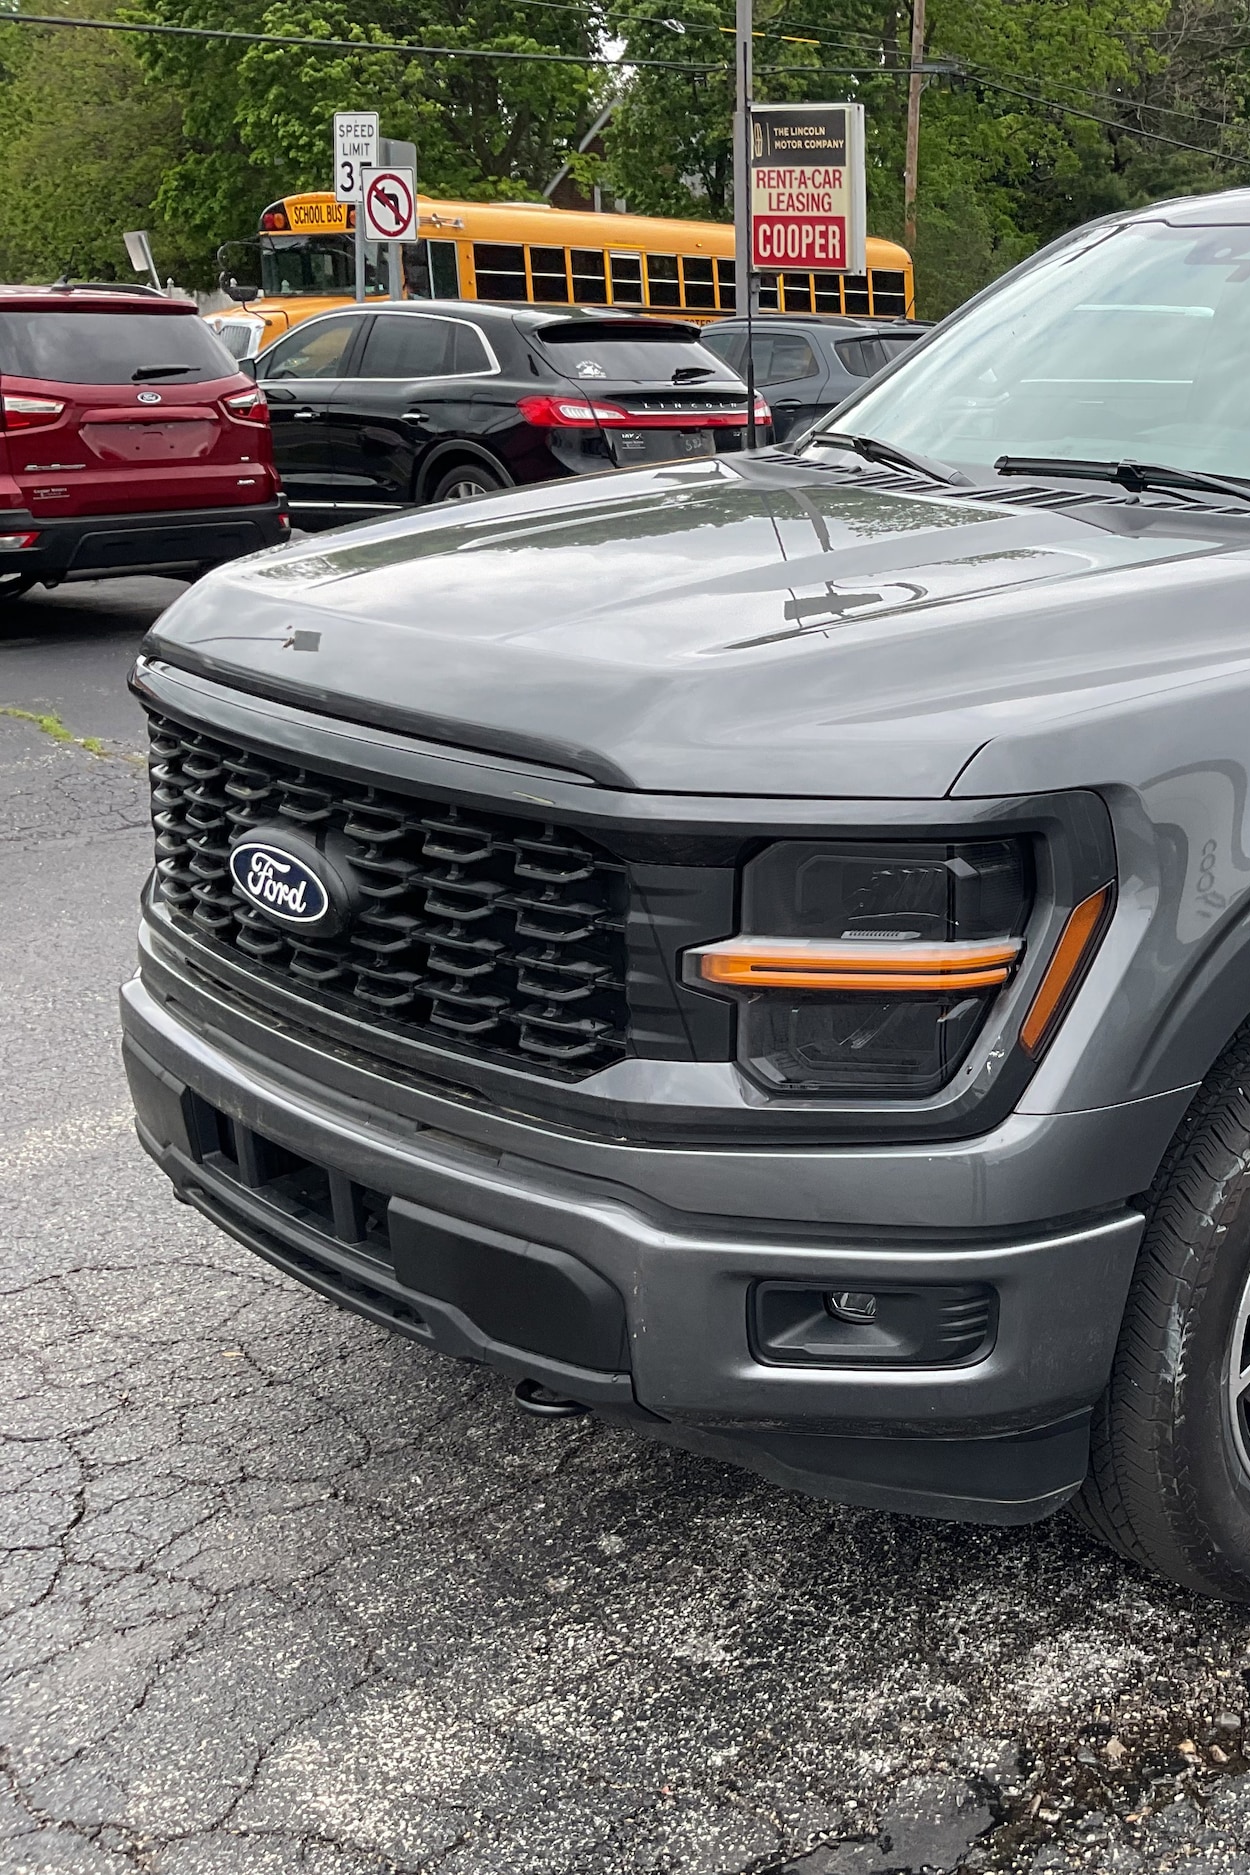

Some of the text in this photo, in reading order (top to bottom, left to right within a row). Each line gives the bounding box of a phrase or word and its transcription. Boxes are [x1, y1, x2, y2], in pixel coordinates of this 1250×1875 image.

[339, 124, 375, 138] SPEED
[773, 126, 826, 137] THE LINCOLN
[342, 143, 370, 156] LIMIT
[774, 139, 844, 149] MOTOR COMPANY
[756, 169, 843, 189] RENT-A-CAR
[768, 192, 832, 212] LEASING
[294, 204, 343, 224] SCHOOL BUS
[758, 223, 841, 259] COOPER
[247, 851, 307, 913] Ford
